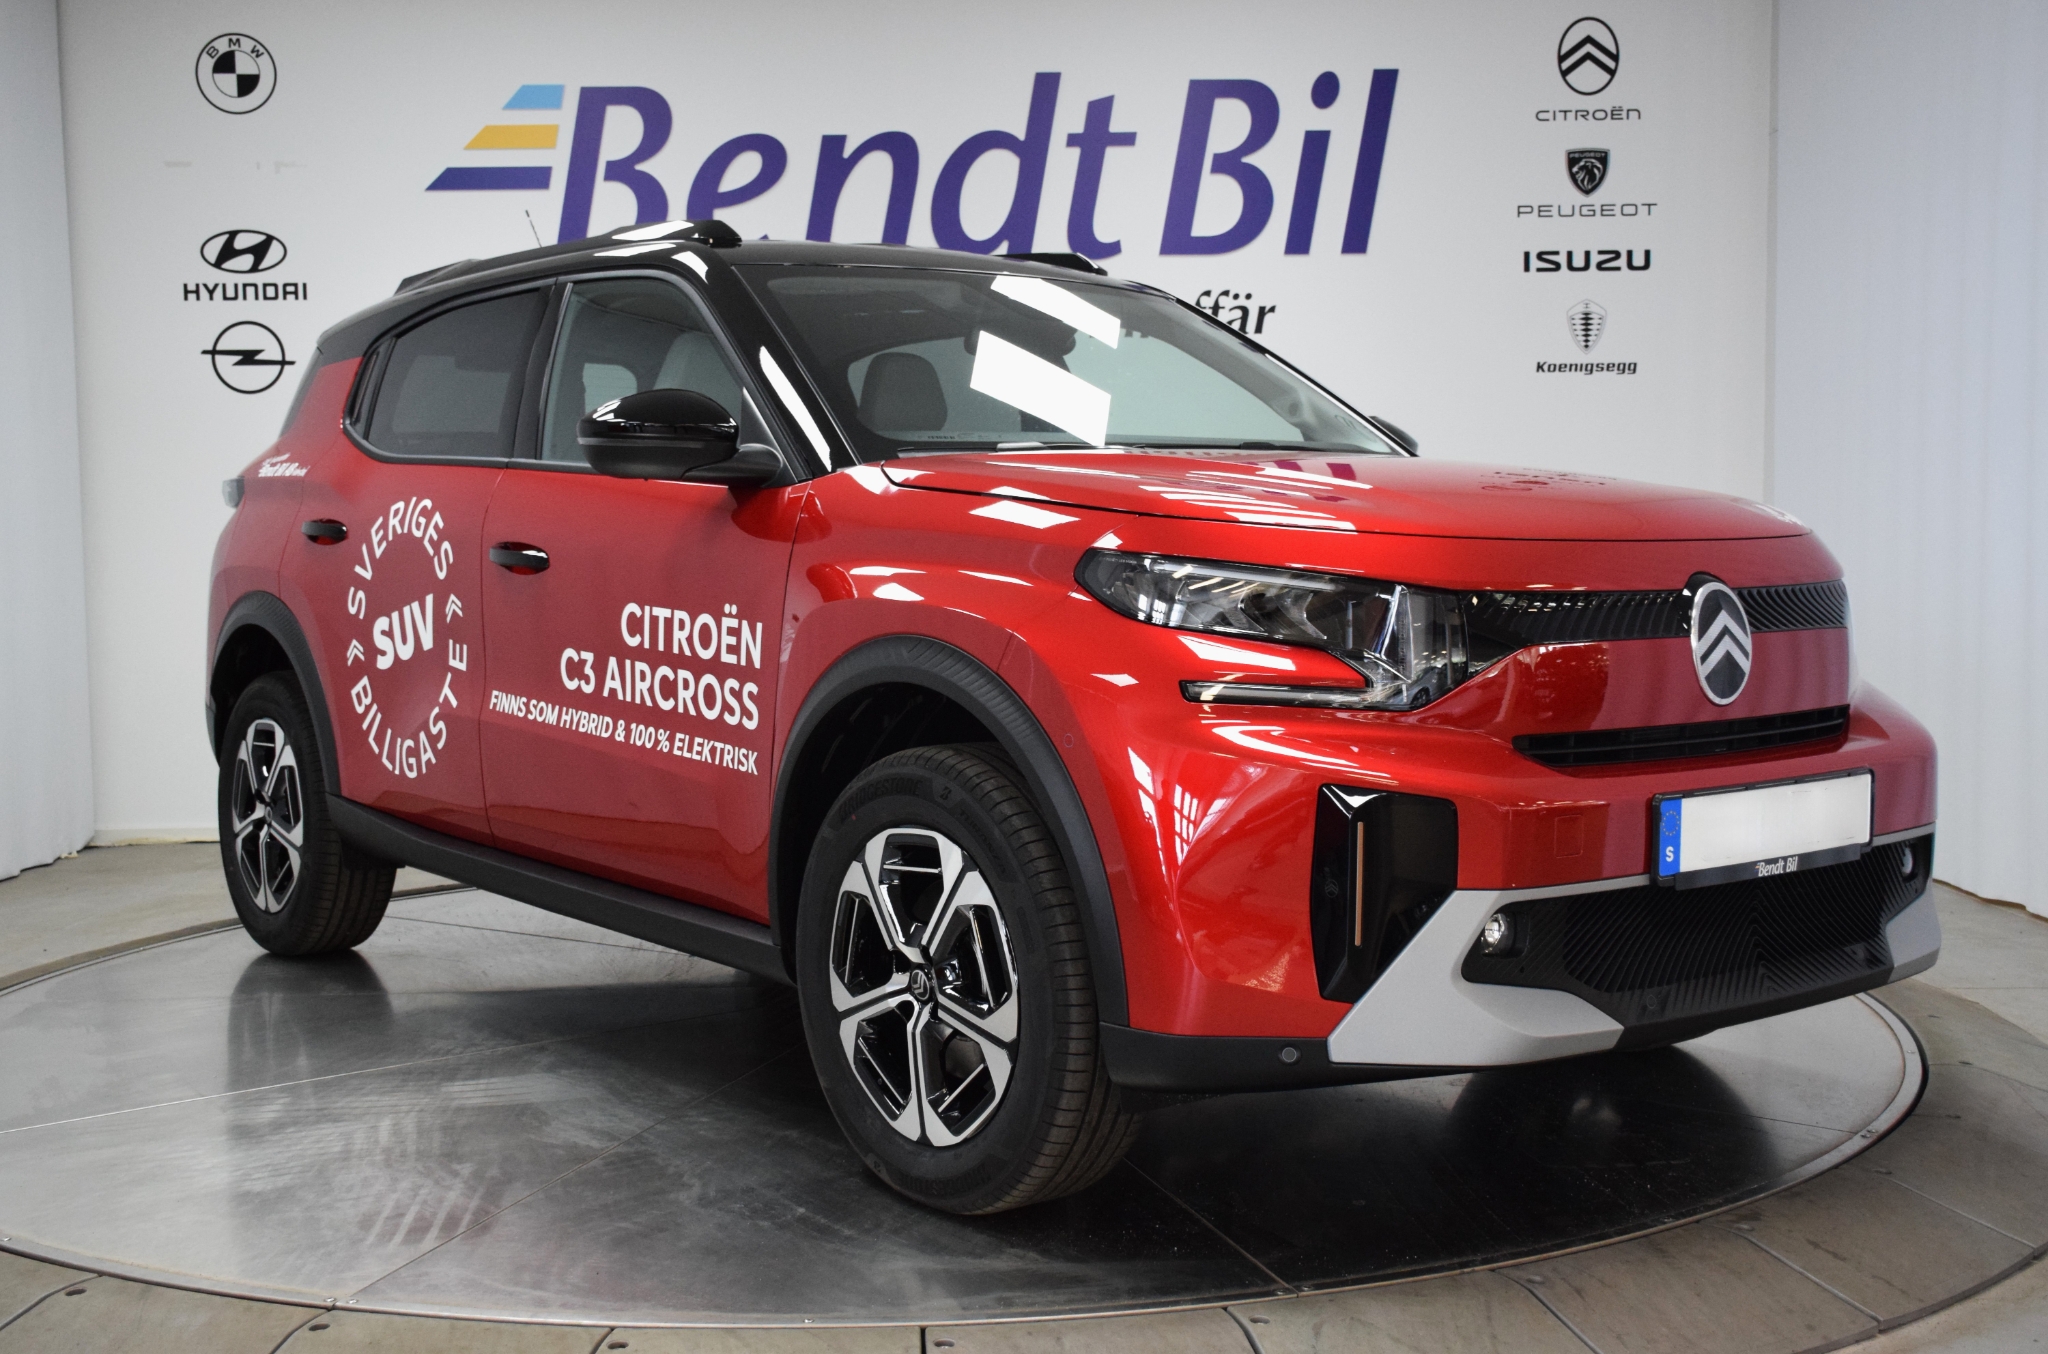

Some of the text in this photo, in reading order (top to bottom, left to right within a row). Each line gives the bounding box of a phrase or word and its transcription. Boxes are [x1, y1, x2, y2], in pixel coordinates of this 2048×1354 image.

[206, 37, 265, 59] BMW
[1535, 106, 1641, 122] CITROËN
[557, 69, 1399, 260] Bendt Bil
[1517, 203, 1657, 218] PEUGEOT
[1523, 249, 1651, 273] ISUZU
[183, 282, 307, 301] HYUNDAI
[1536, 361, 1638, 376] Koenigsegg
[347, 496, 454, 620] SVERIGES
[373, 593, 434, 670] SUV
[620, 602, 763, 670] CITROËN
[560, 647, 760, 731] C3 AIRCROSS
[350, 638, 468, 779] BILLIGASTE
[489, 690, 528, 718] FINNS
[527, 699, 560, 726] SOM
[560, 706, 614, 739] HYBRID
[614, 719, 626, 742] &
[673, 732, 759, 776] ELEKTRISK
[1665, 846, 1675, 862] S
[1758, 856, 1798, 877] Bendt Bil
